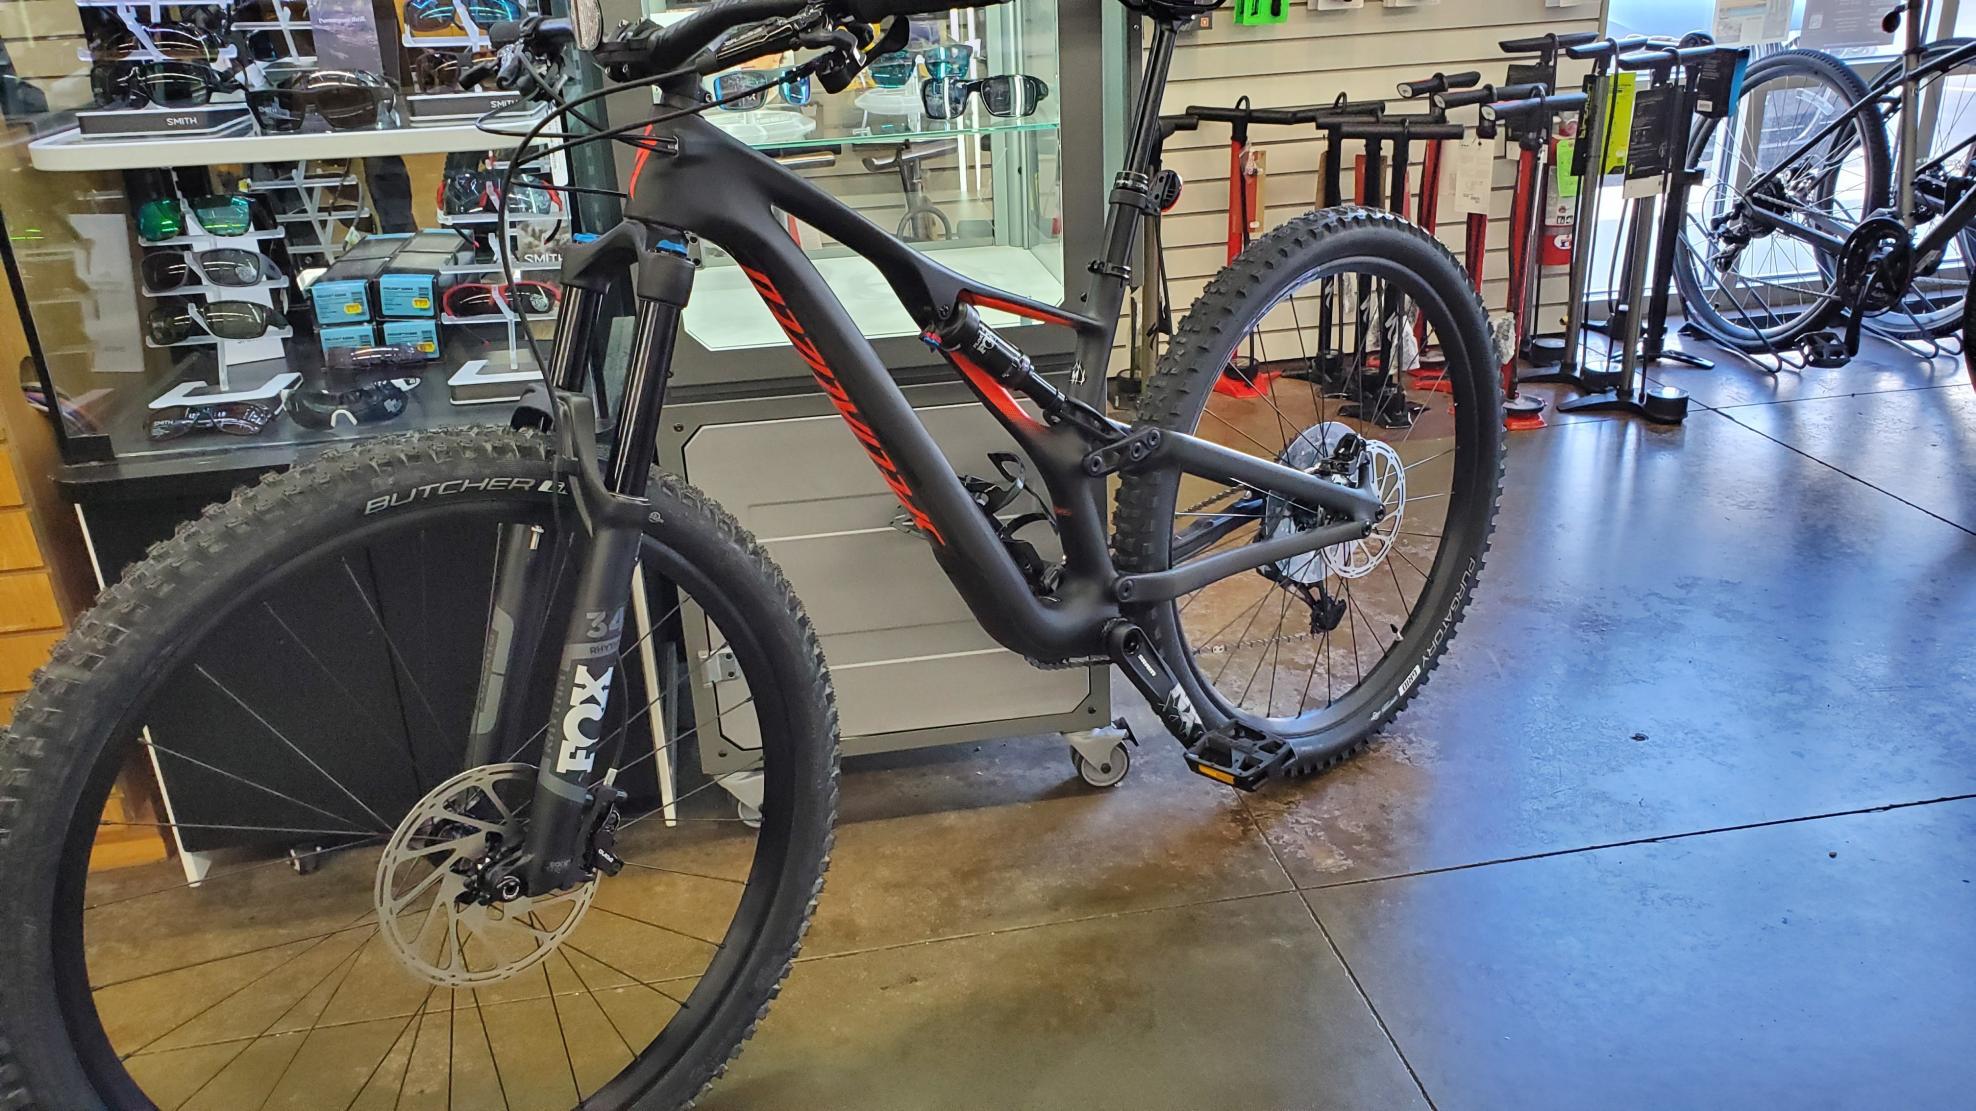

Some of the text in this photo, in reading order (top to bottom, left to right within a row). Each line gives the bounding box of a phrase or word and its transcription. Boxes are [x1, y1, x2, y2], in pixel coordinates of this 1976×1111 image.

[490, 99, 519, 108] SMIT
[166, 117, 197, 126] SMITH
[364, 477, 536, 516] BUTCHER
[586, 607, 625, 638] 34
[1422, 556, 1476, 668] PURGATORY
[590, 641, 619, 655] RHYT
[556, 664, 614, 774] FOX
